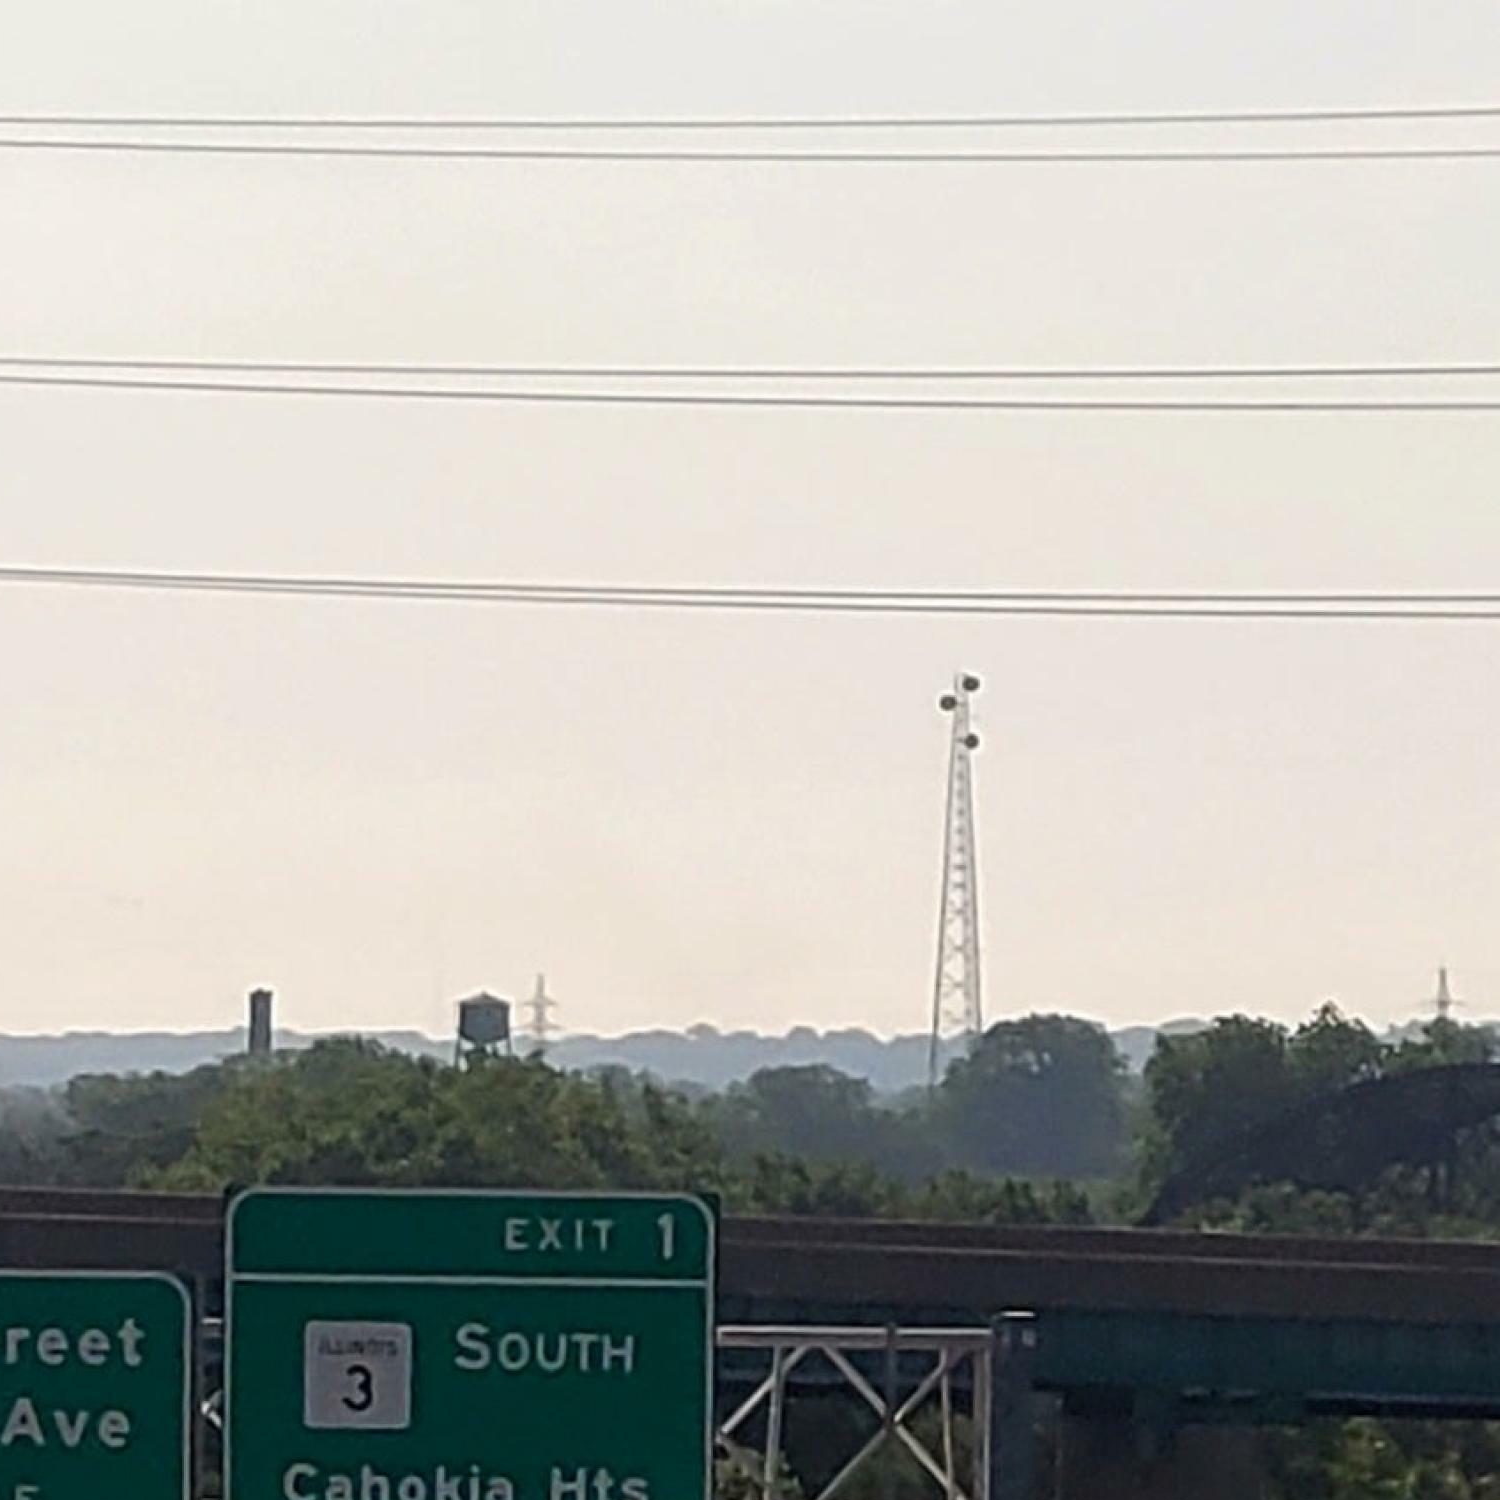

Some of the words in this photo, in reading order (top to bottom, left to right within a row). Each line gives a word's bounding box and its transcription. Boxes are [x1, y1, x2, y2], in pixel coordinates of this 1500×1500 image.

[504, 1218, 614, 1251] EXIT
[657, 1213, 675, 1260] 1
[454, 1322, 635, 1374] SOUTH
[341, 1364, 374, 1412] 3
[0, 1397, 131, 1448] Ave
